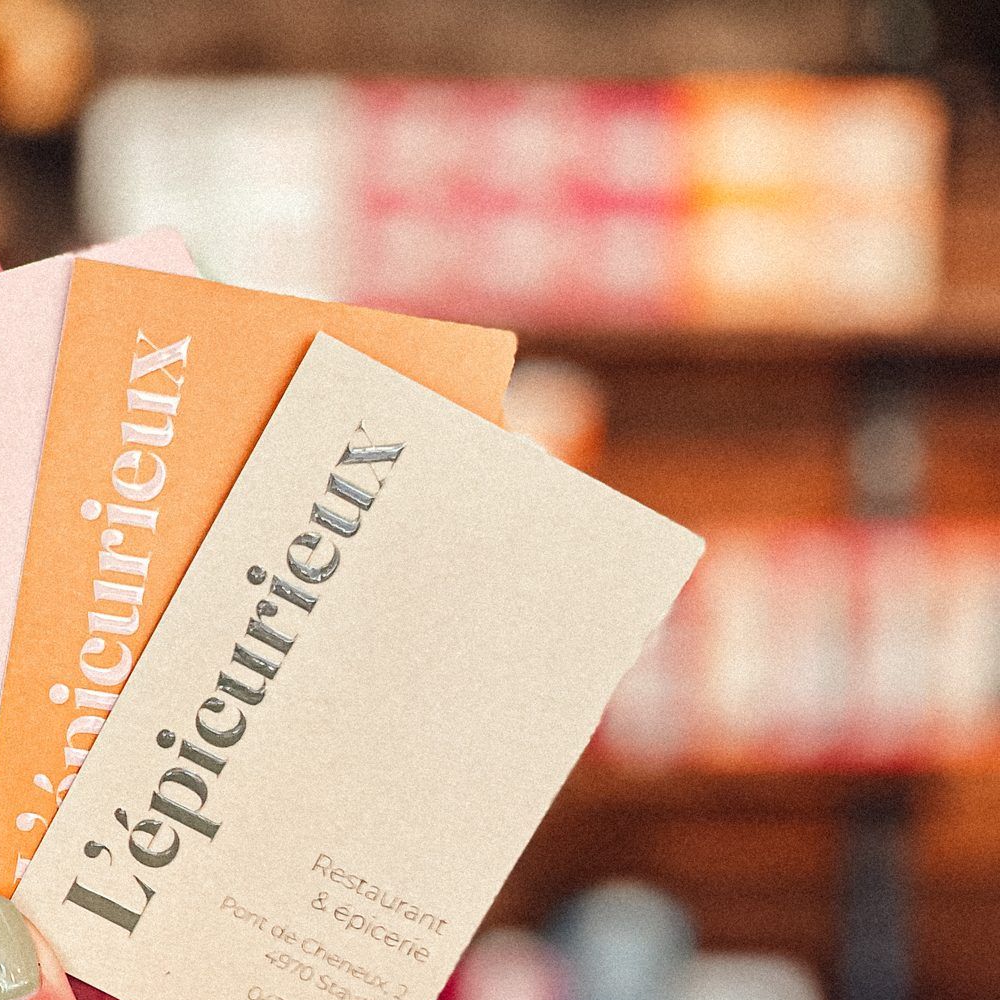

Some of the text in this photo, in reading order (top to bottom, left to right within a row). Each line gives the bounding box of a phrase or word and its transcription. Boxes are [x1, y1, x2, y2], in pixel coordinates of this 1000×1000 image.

[13, 328, 191, 885] 'icurieux
[62, 420, 406, 936] L'épicurieux
[219, 896, 268, 932] Pont
[271, 923, 298, 945] de
[311, 891, 431, 963] & épicerie
[312, 853, 447, 935] Restaurant
[265, 951, 315, 982] 4970
